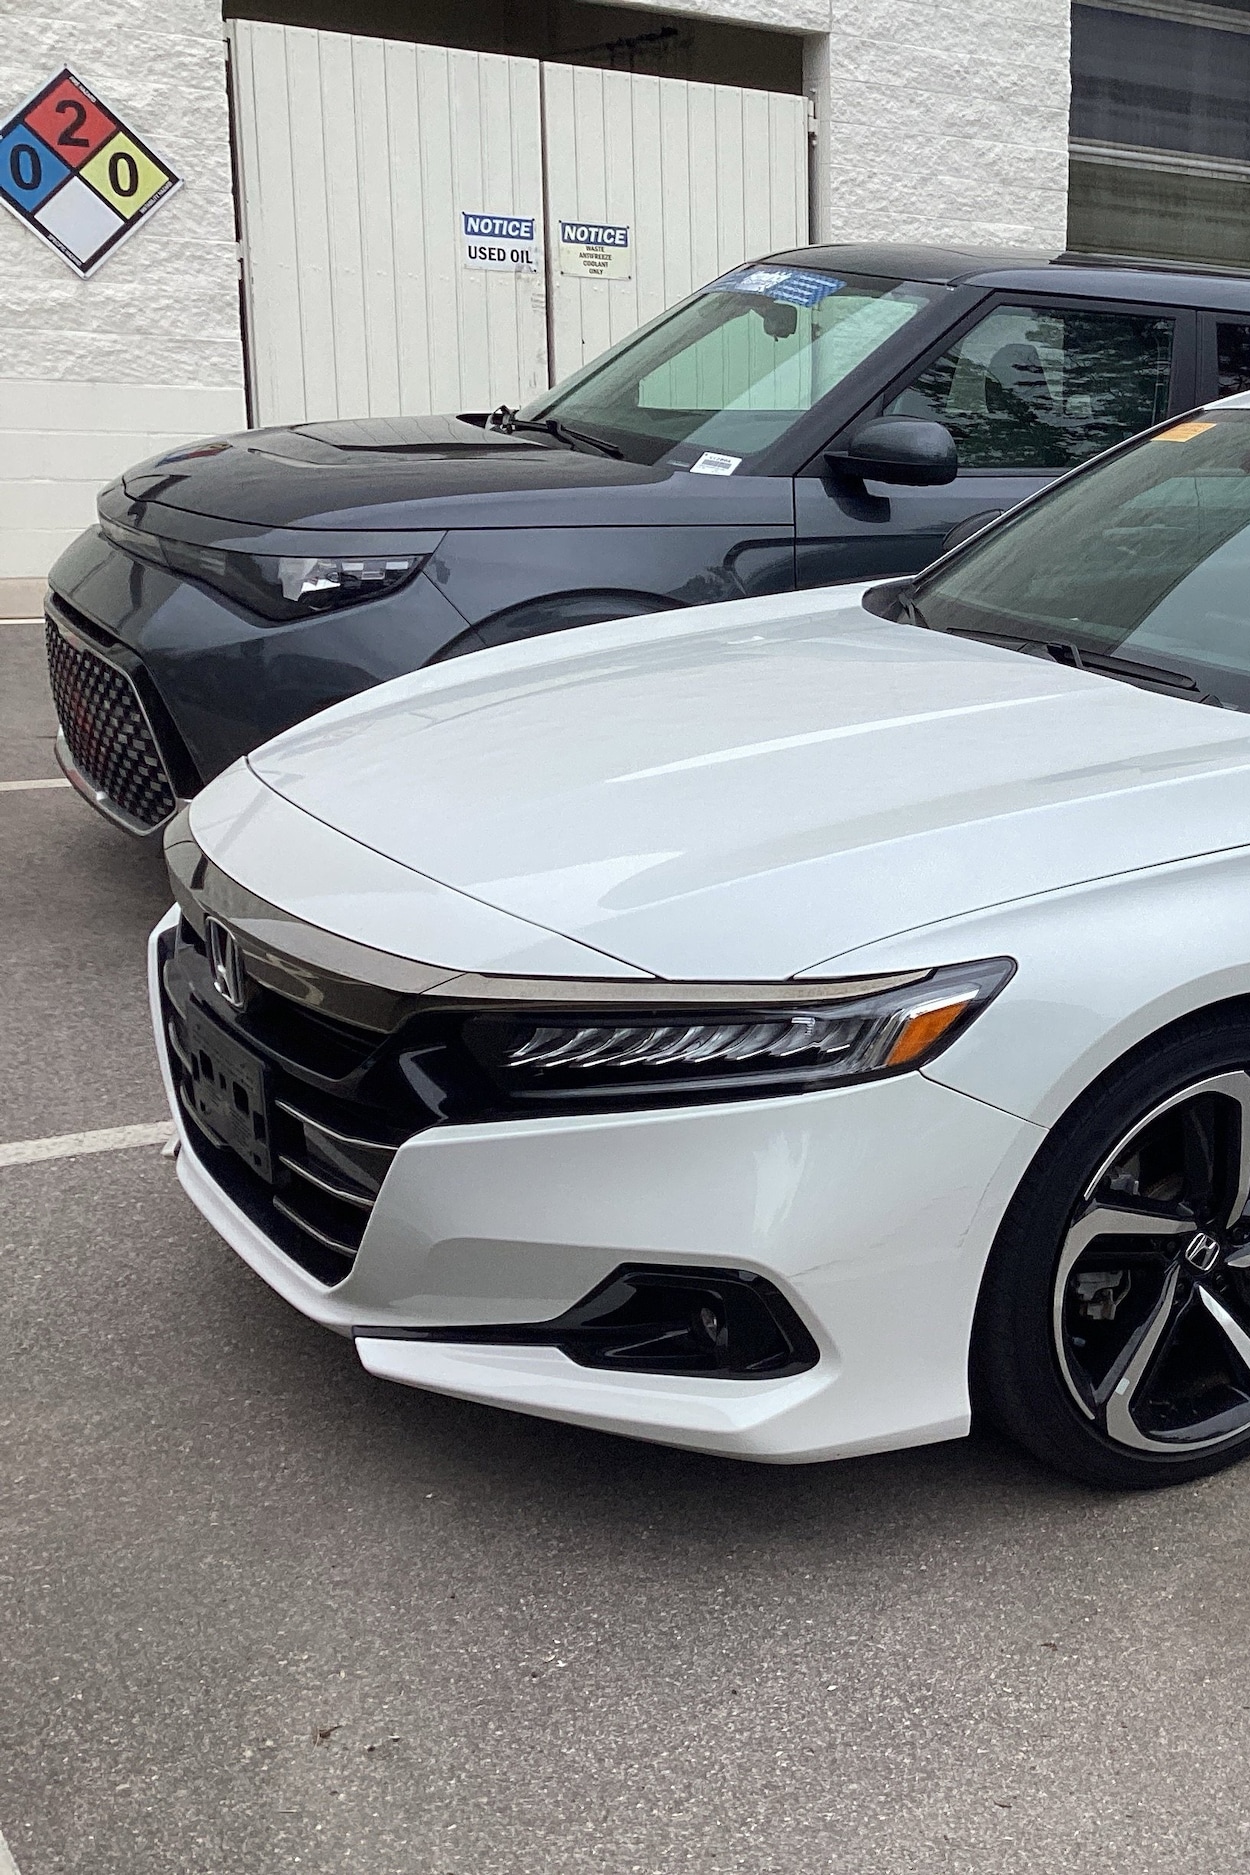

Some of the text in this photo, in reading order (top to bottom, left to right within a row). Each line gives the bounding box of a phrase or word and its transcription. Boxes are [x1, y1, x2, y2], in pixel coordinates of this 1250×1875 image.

[55, 99, 90, 147] 2
[9, 143, 42, 191] 0
[108, 151, 139, 197] 0
[467, 217, 532, 237] NOTICE
[564, 225, 626, 245] NOTICE
[468, 245, 533, 264] USED OIL
[579, 252, 612, 261] ANTIFREEZE
[583, 260, 609, 268] COOLANT
